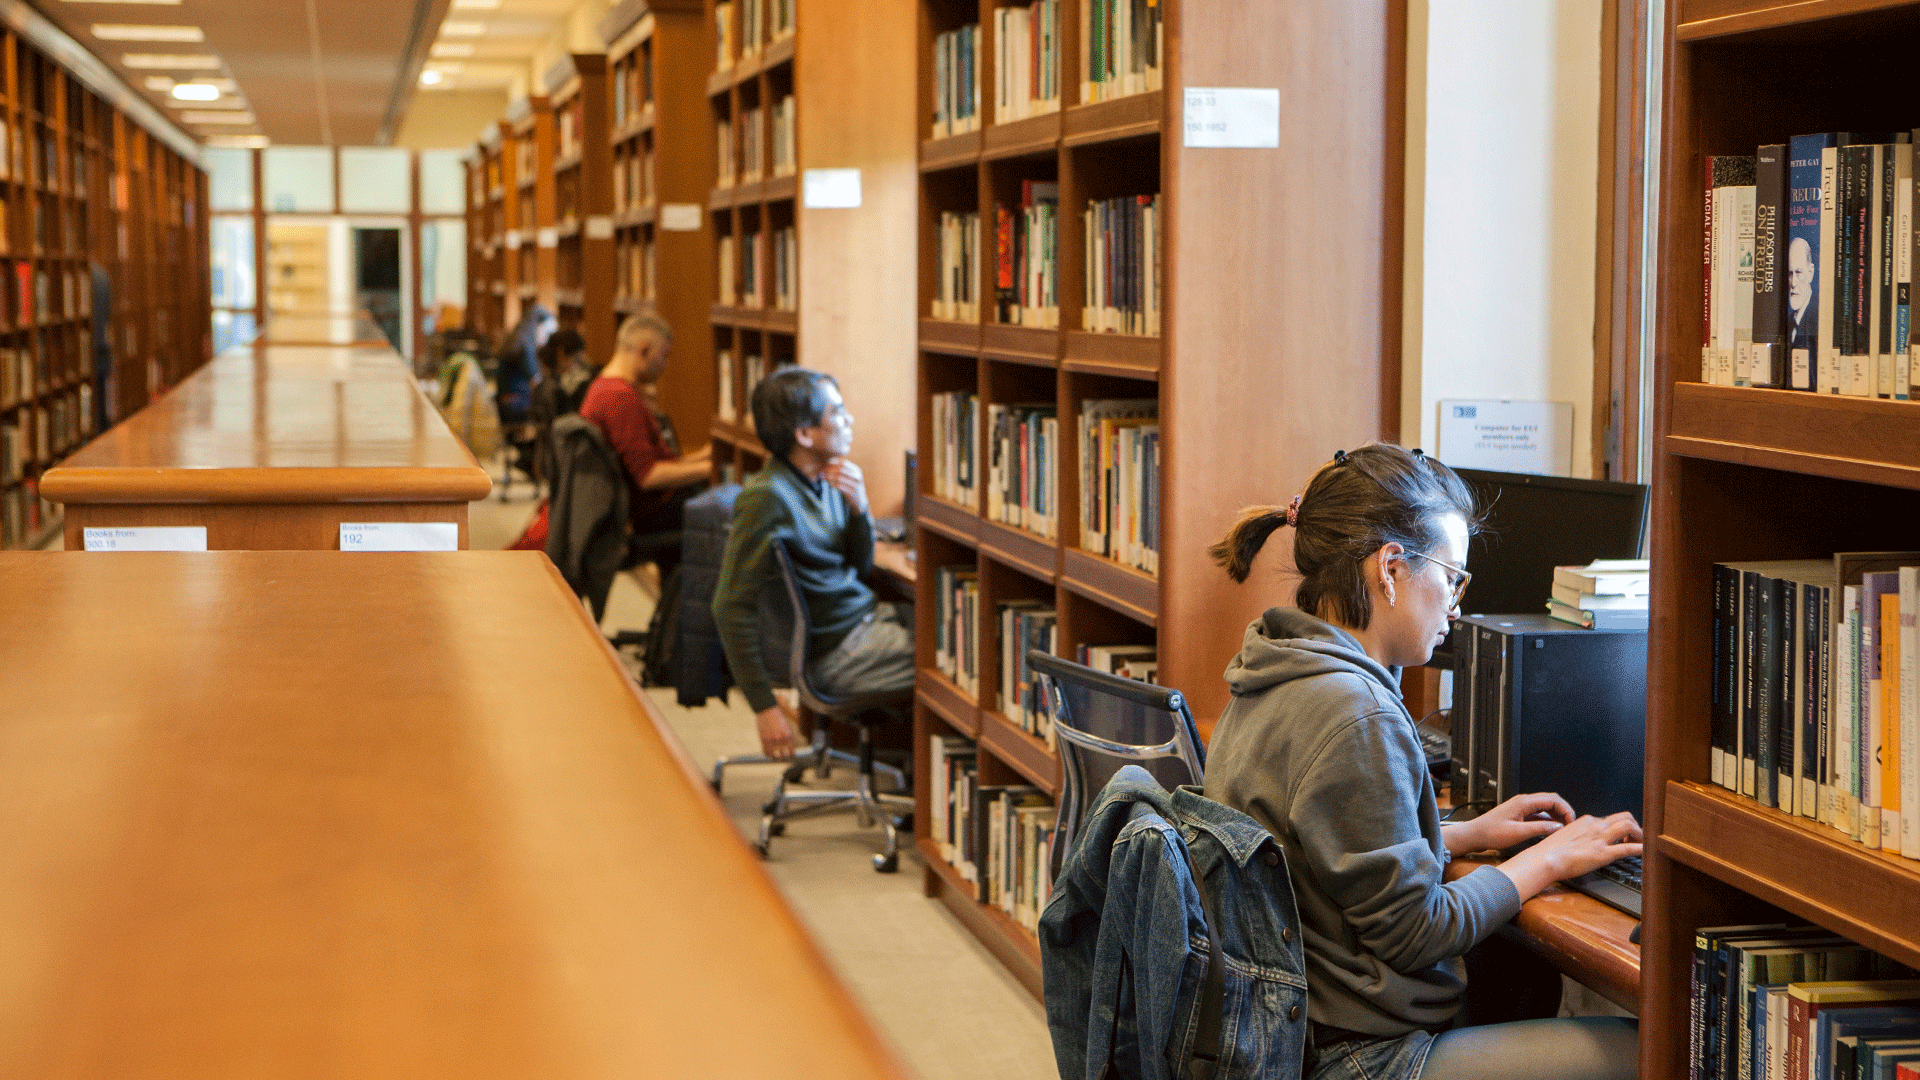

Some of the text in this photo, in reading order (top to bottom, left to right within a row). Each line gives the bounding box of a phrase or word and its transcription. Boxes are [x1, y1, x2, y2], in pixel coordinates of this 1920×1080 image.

[1808, 158, 1819, 166] GAY
[1824, 167, 1833, 210] Freud
[1755, 204, 1766, 294] ON FREUD
[1765, 206, 1775, 293] PHILOSOPHERS
[1859, 258, 1865, 266] of
[344, 534, 363, 544] 192
